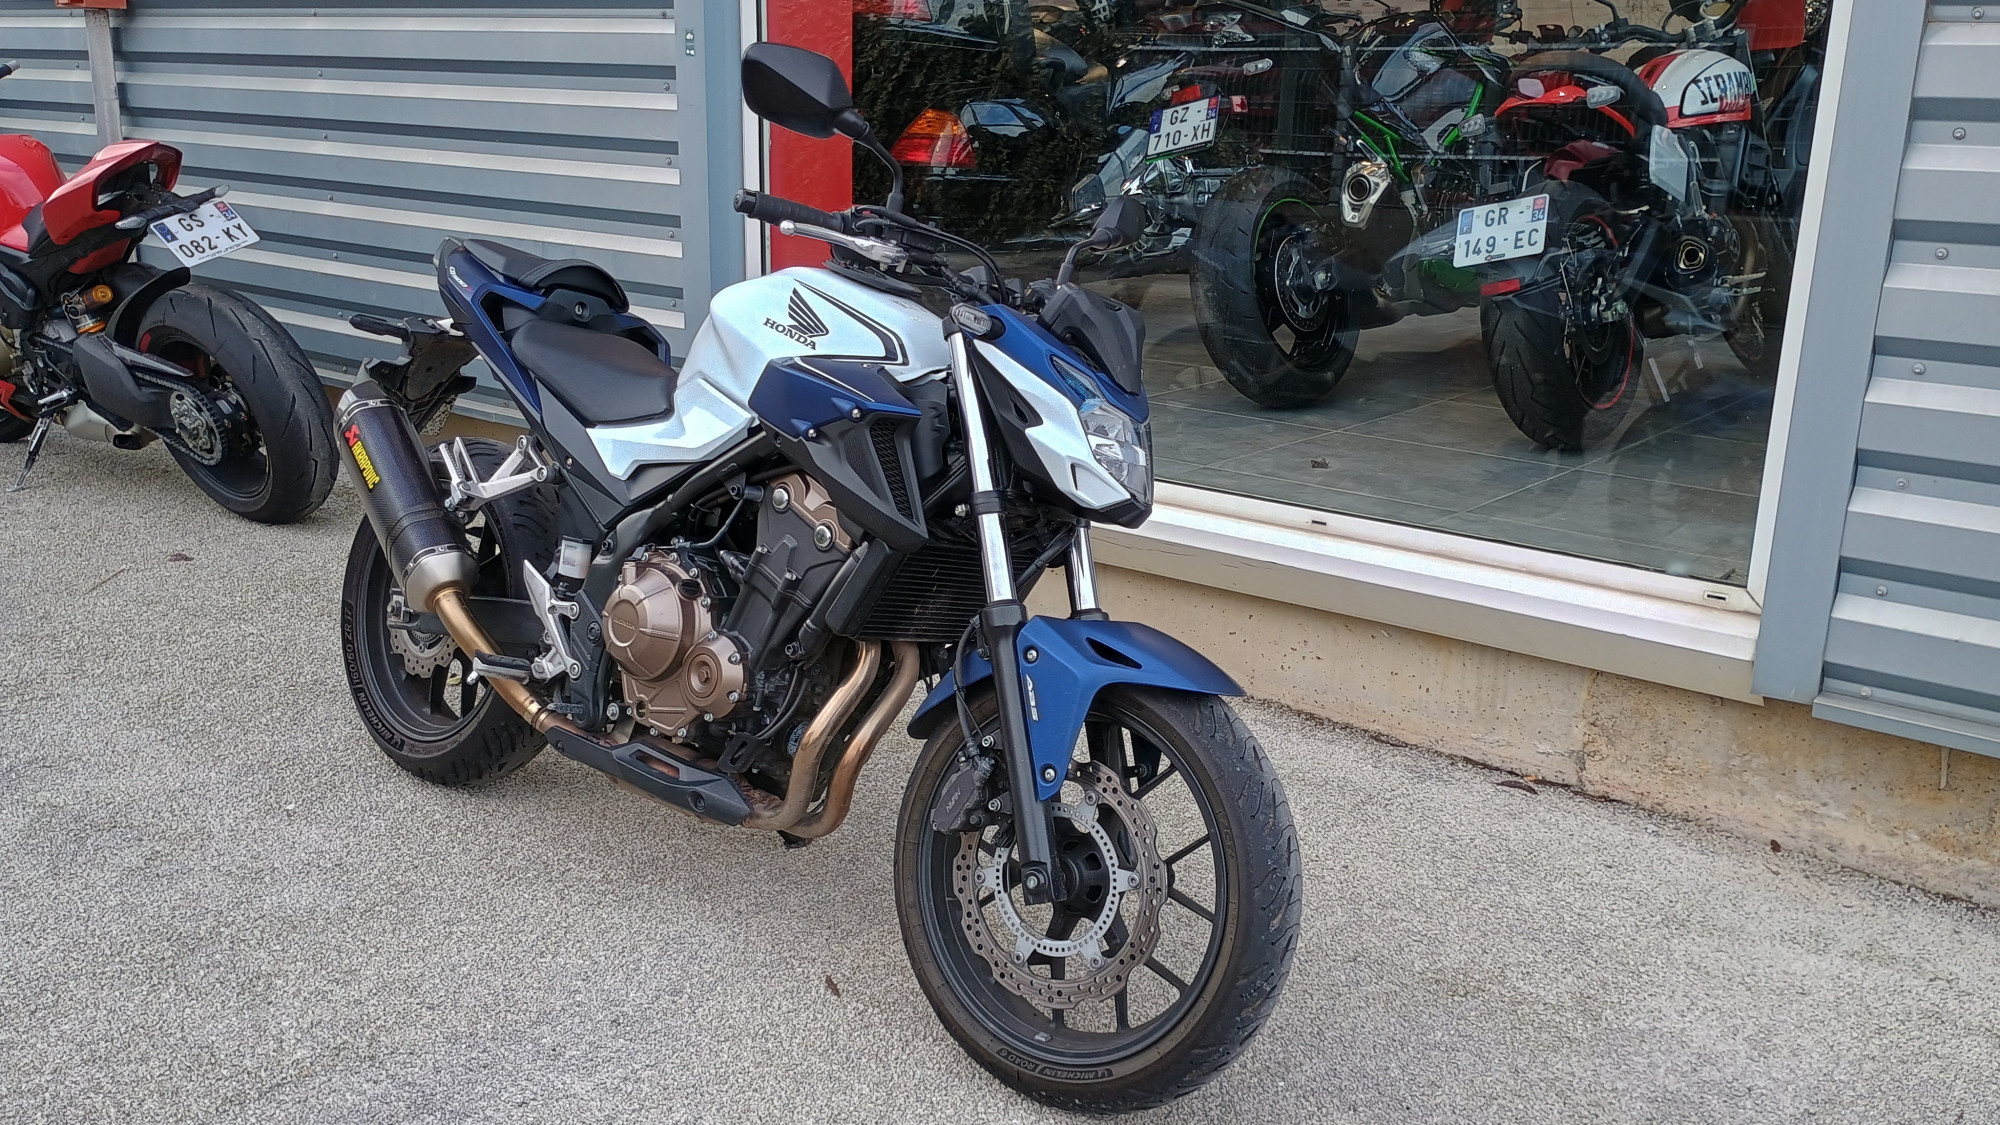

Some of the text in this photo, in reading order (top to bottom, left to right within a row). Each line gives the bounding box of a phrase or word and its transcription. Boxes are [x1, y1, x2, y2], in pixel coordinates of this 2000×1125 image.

[1154, 122, 1211, 151] 710-XH
[222, 209, 236, 220] 34
[1484, 207, 1509, 227] GR
[1532, 209, 1544, 220] 34
[179, 223, 248, 258] 082-KY
[1464, 228, 1539, 258] 149-EC
[763, 317, 817, 350] HONDA
[1025, 673, 1039, 722] ABS
[357, 690, 394, 741] MICHELIN
[1000, 1049, 1096, 1079] MICHELIN ROAD 6
